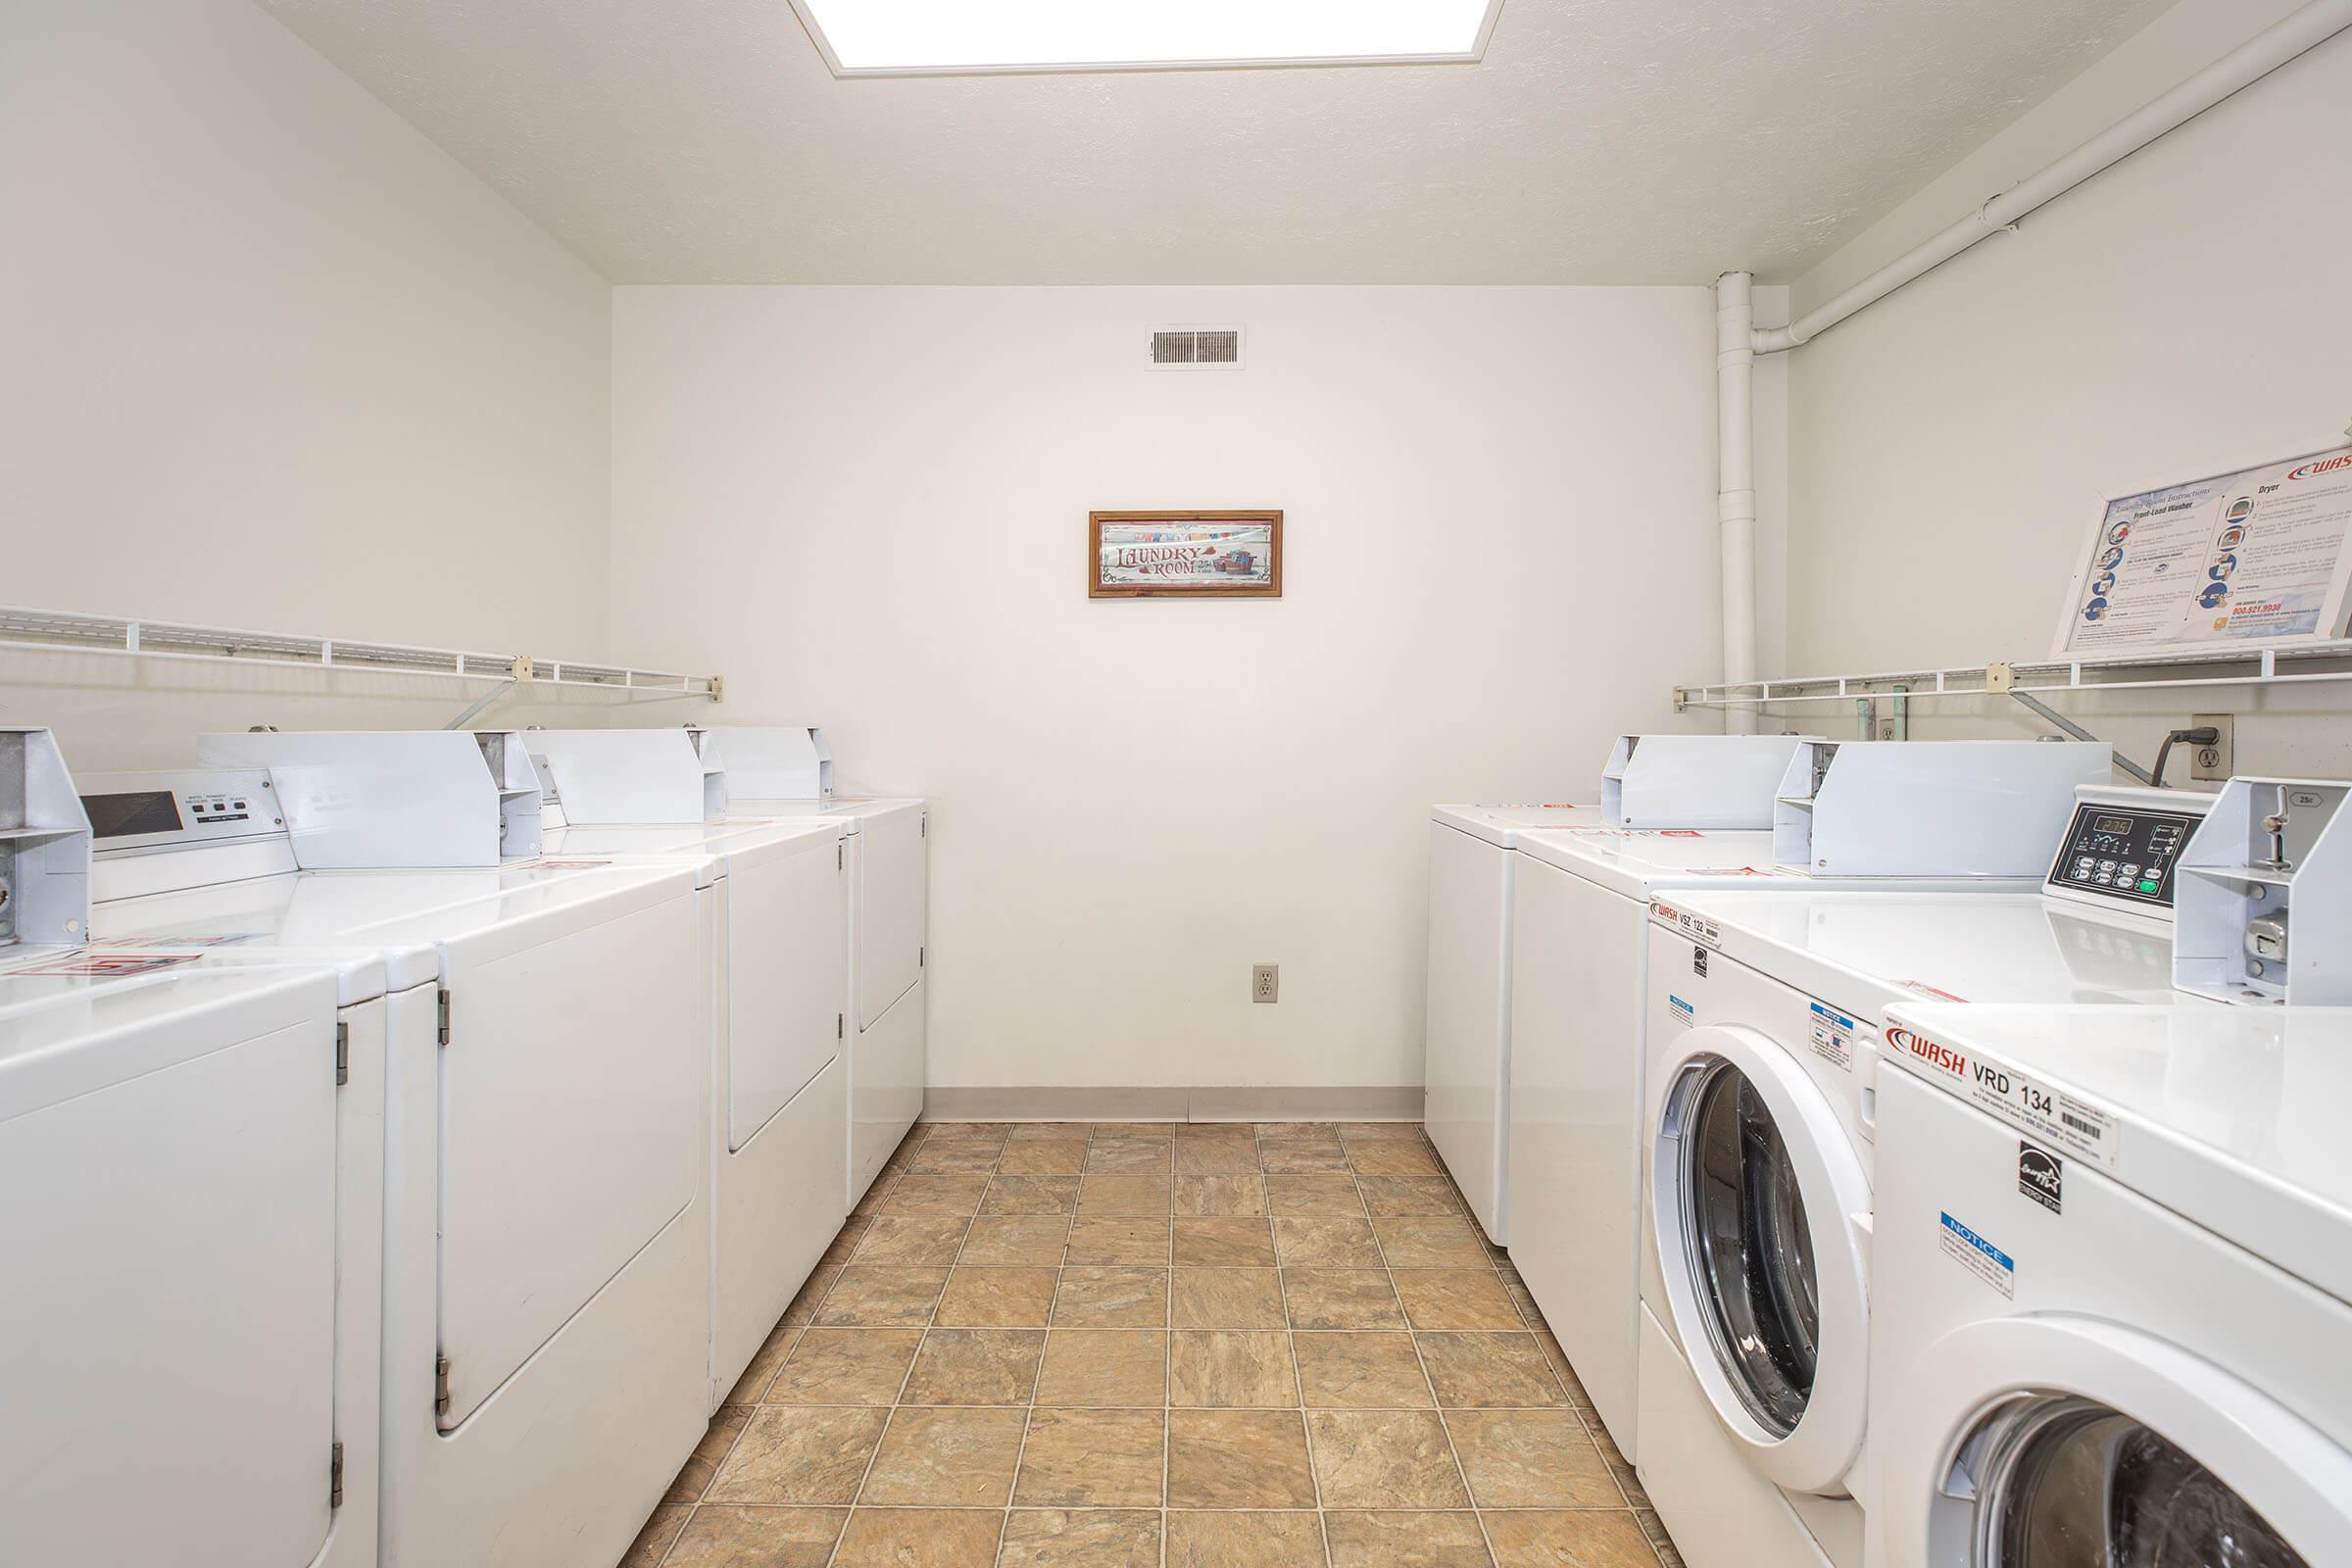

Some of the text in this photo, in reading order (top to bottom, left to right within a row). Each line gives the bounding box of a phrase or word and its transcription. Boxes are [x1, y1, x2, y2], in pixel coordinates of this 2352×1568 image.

[2258, 484, 2280, 494] Dryer
[2133, 502, 2193, 519] Front-Load Washer
[1115, 547, 1201, 569] LAUNDRY
[1153, 561, 1195, 578] ROOM
[1659, 905, 1678, 921] WASH
[1910, 1034, 1966, 1075] WASH
[1973, 1061, 2009, 1095] VRD
[2021, 1085, 2052, 1116] 134
[1950, 1219, 2004, 1264] NOTICE
